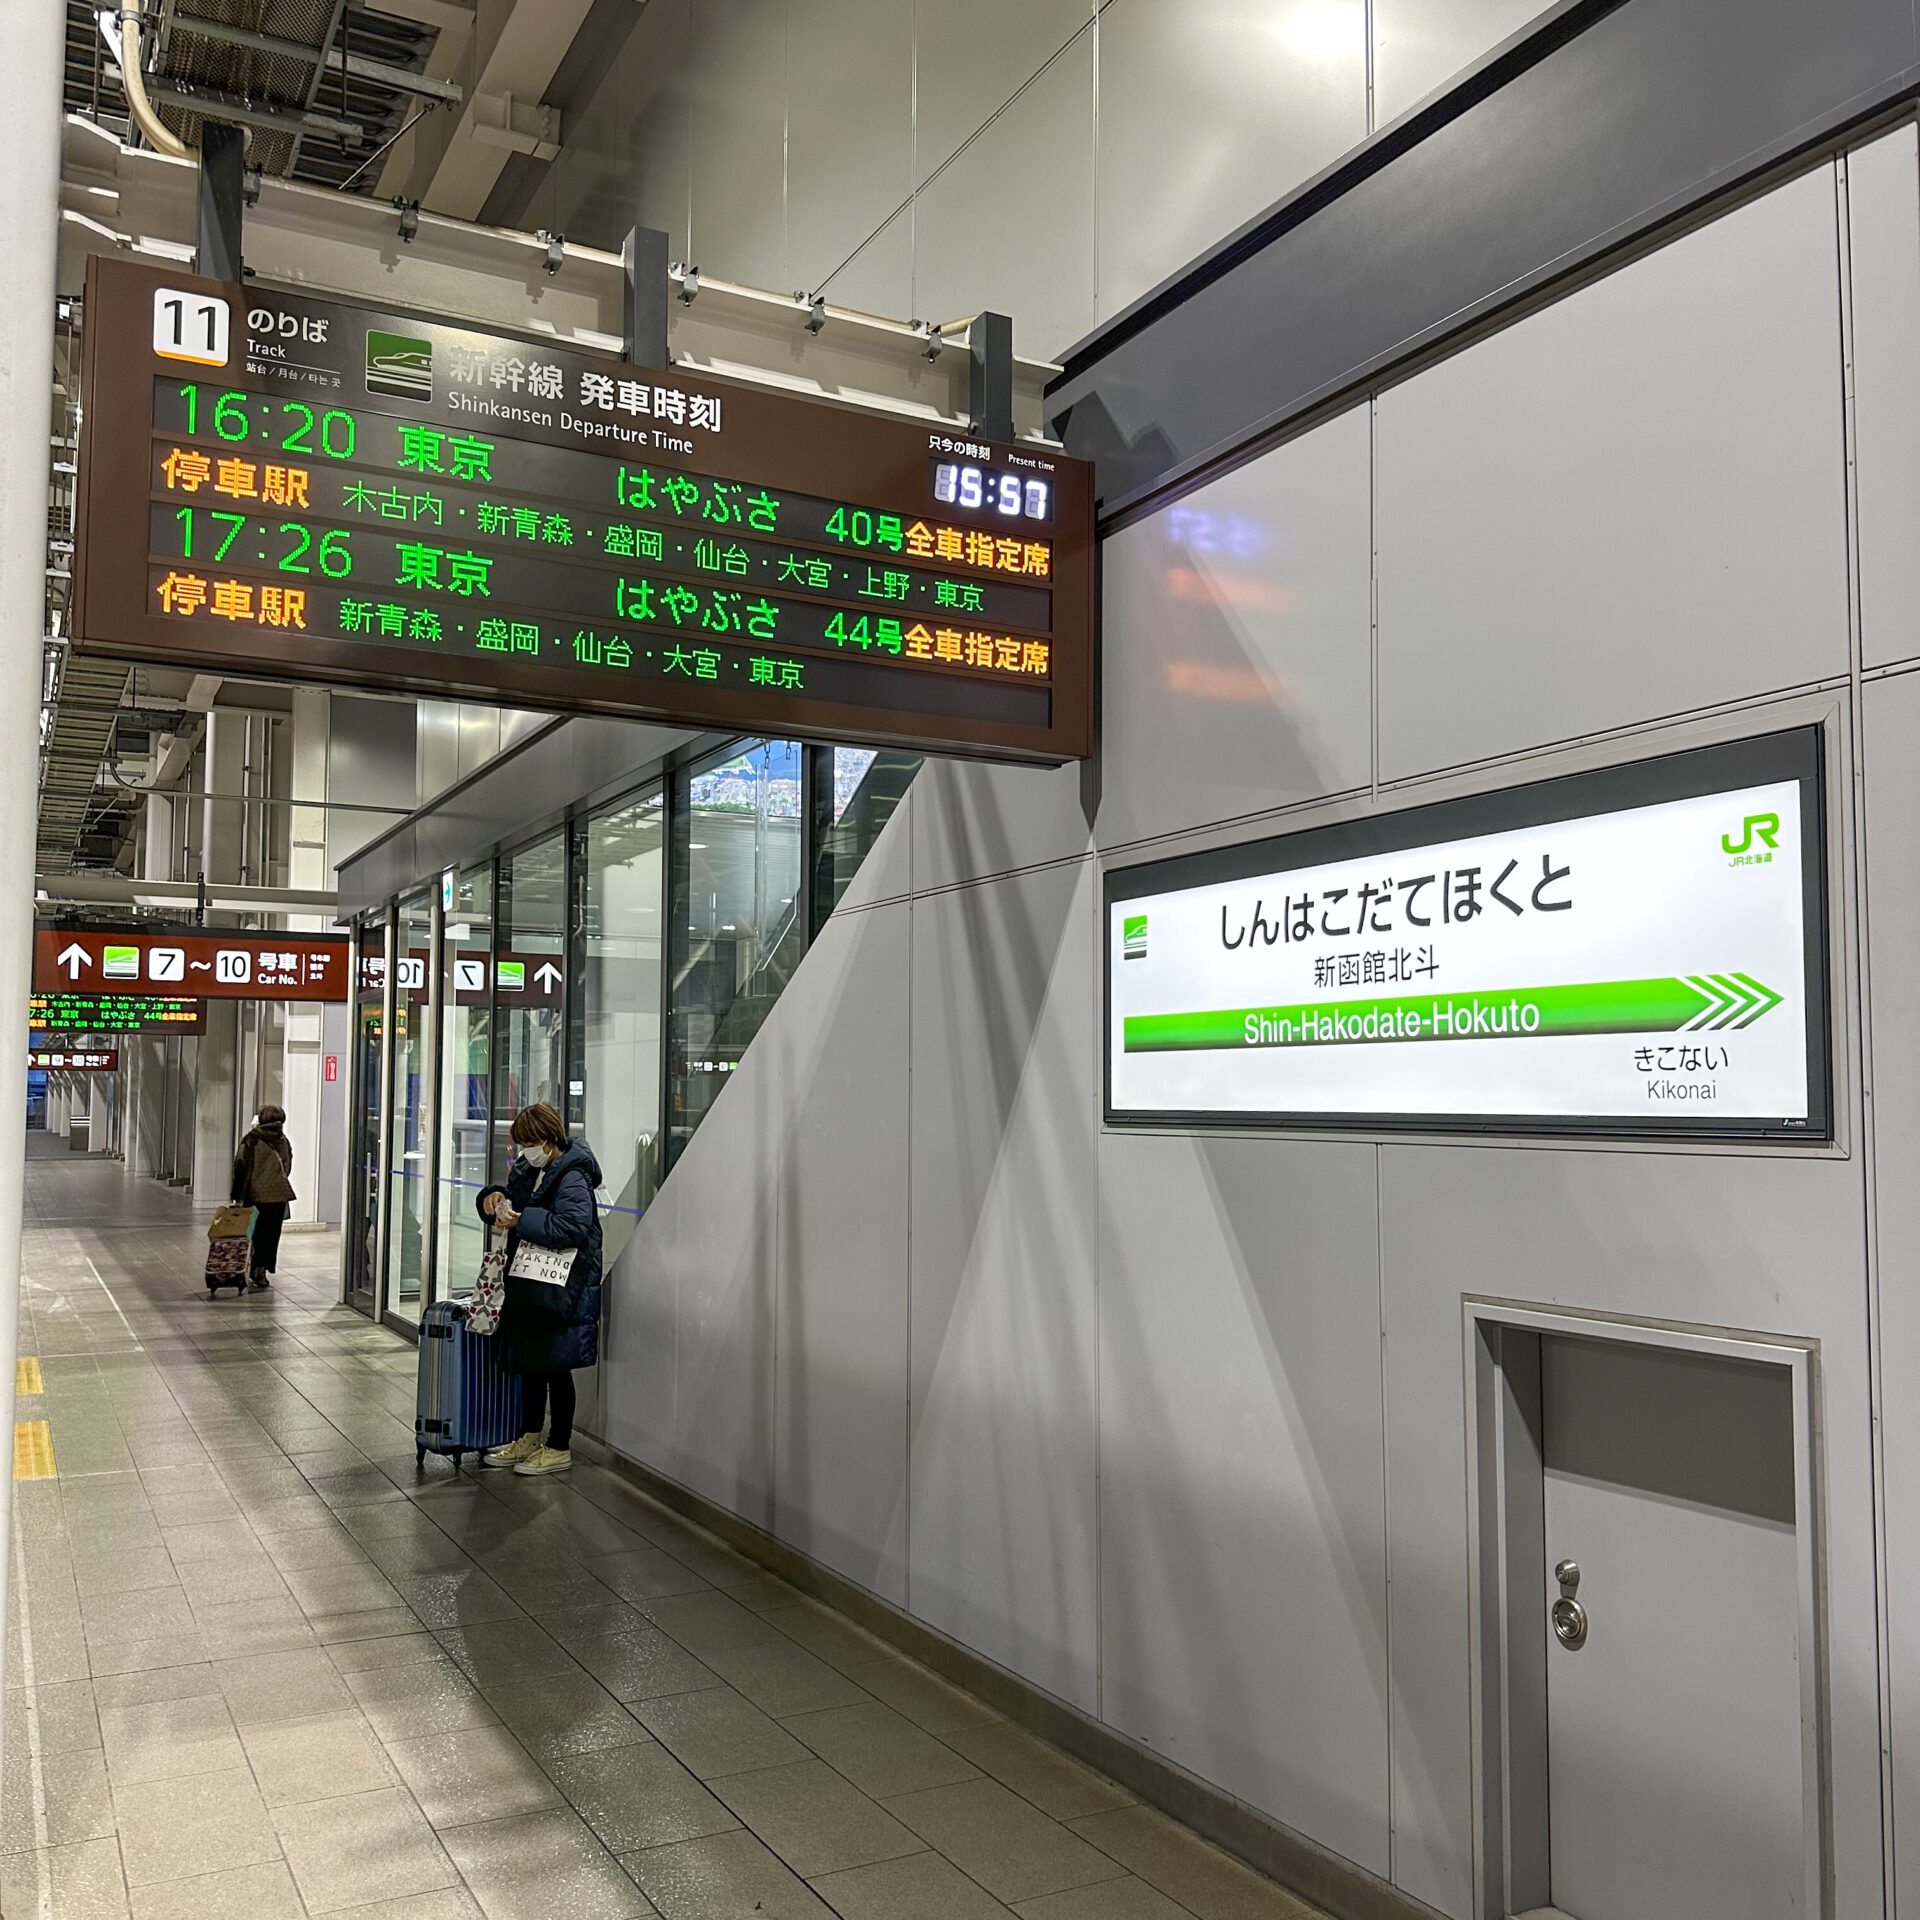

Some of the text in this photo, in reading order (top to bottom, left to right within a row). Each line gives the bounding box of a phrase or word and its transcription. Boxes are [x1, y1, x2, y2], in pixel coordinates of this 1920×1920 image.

[163, 299, 217, 353] 11
[247, 308, 329, 343] のりば
[246, 338, 286, 359] Track
[449, 347, 721, 433] 新幹線 発車時刻
[448, 391, 693, 454] Shinkansen Departure Time
[929, 434, 991, 461] 只今の時刻
[1008, 453, 1056, 472] Present time
[160, 447, 310, 509] 停車駅
[178, 383, 356, 460] 16:20
[397, 425, 495, 482] 東京
[617, 466, 780, 532] はやぶさ
[904, 520, 1049, 577] 全車指定席
[947, 464, 1048, 520] 15:57
[156, 572, 307, 629] 停車駅
[175, 506, 353, 579] 17:26
[394, 542, 494, 597] 東京
[616, 578, 780, 639] はやぶさ
[904, 623, 1049, 675] 全車指定席
[1721, 812, 1780, 854] JR
[1219, 854, 1574, 950] しんはこだてほくと
[158, 953, 176, 976] 7
[220, 955, 246, 979] 10
[257, 952, 298, 972] 号車
[257, 974, 298, 986] Car No.
[1313, 945, 1440, 989] 新函館北斗
[1243, 1000, 1540, 1046] Shin-Hakodate-Hokuto
[1633, 1045, 1729, 1072] きこない
[1647, 1079, 1717, 1101] Kikonai
[512, 1264, 568, 1282] IT NOW
[515, 1252, 570, 1270] MAKING
